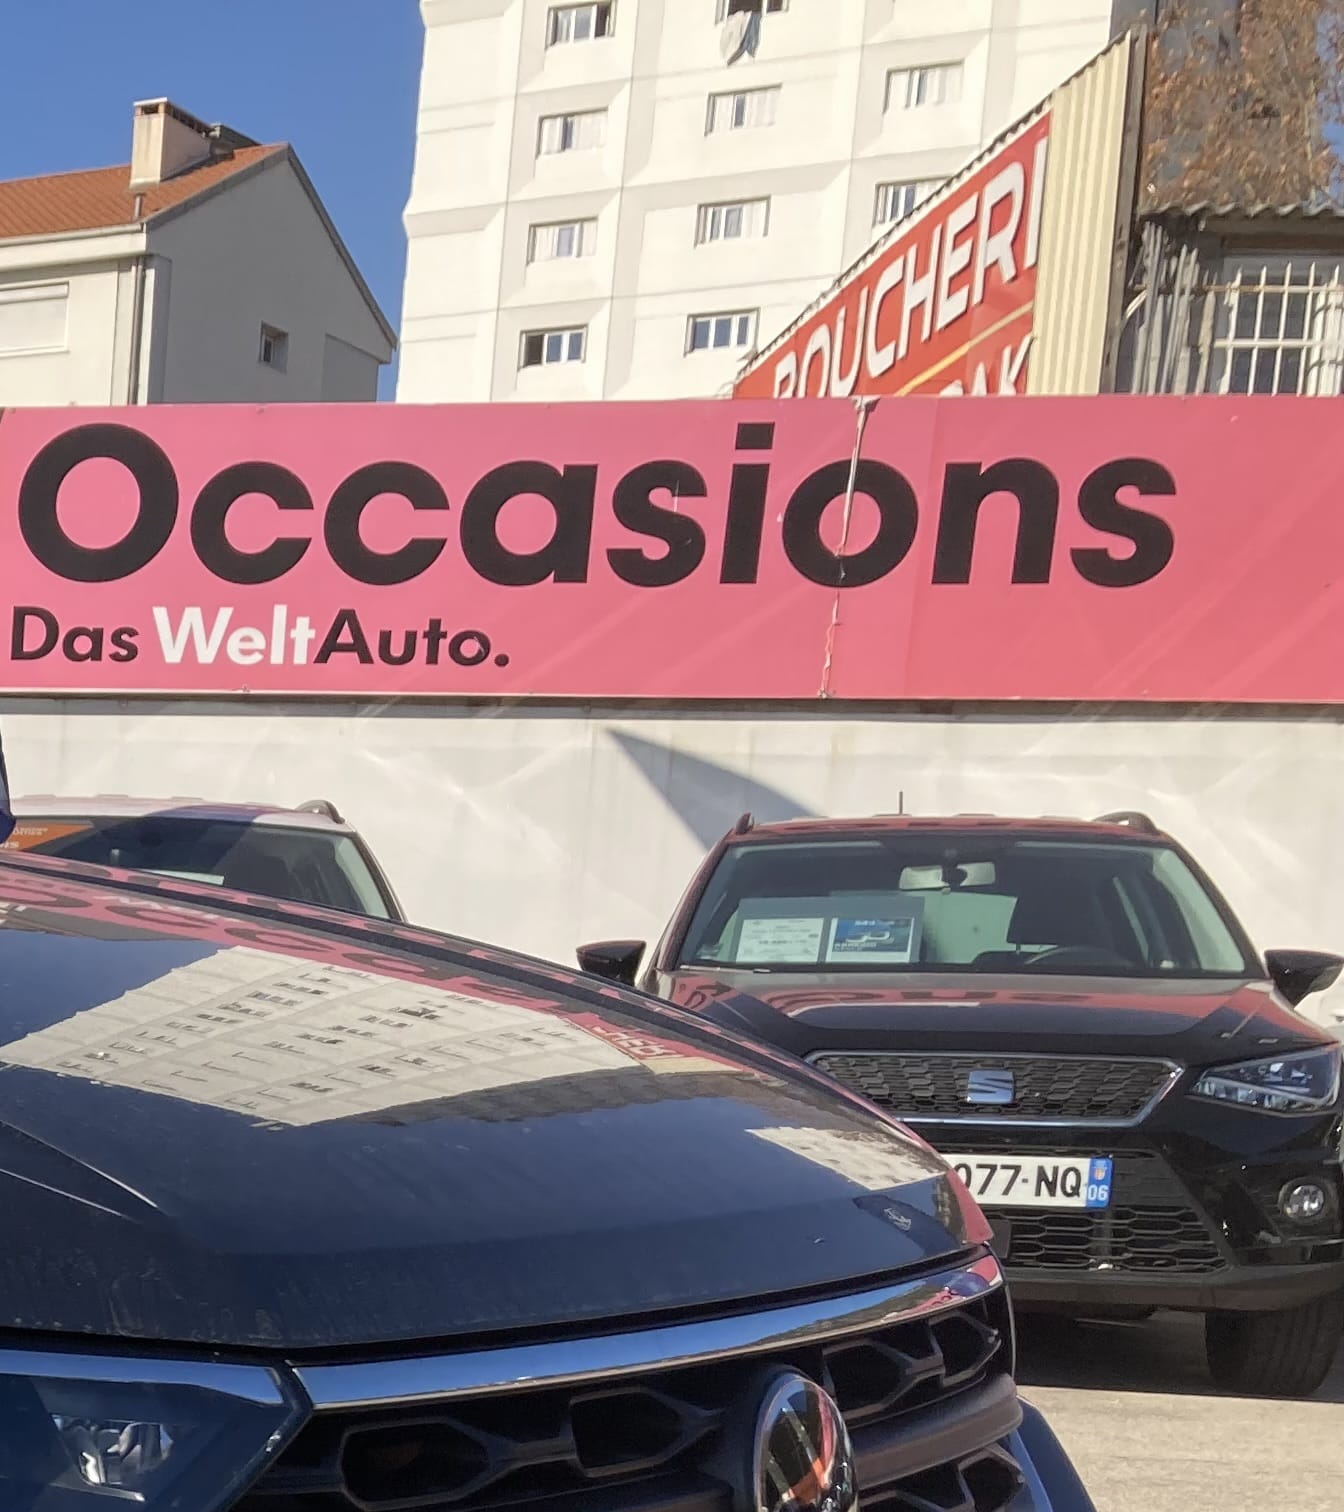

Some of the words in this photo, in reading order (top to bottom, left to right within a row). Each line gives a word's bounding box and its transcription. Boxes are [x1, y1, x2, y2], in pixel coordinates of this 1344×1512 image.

[774, 136, 1048, 398] OUCHERI
[17, 421, 1177, 588] Occasions
[11, 605, 140, 663] Das
[152, 603, 510, 667] WeltAuto.
[1087, 1184, 1109, 1202] 06
